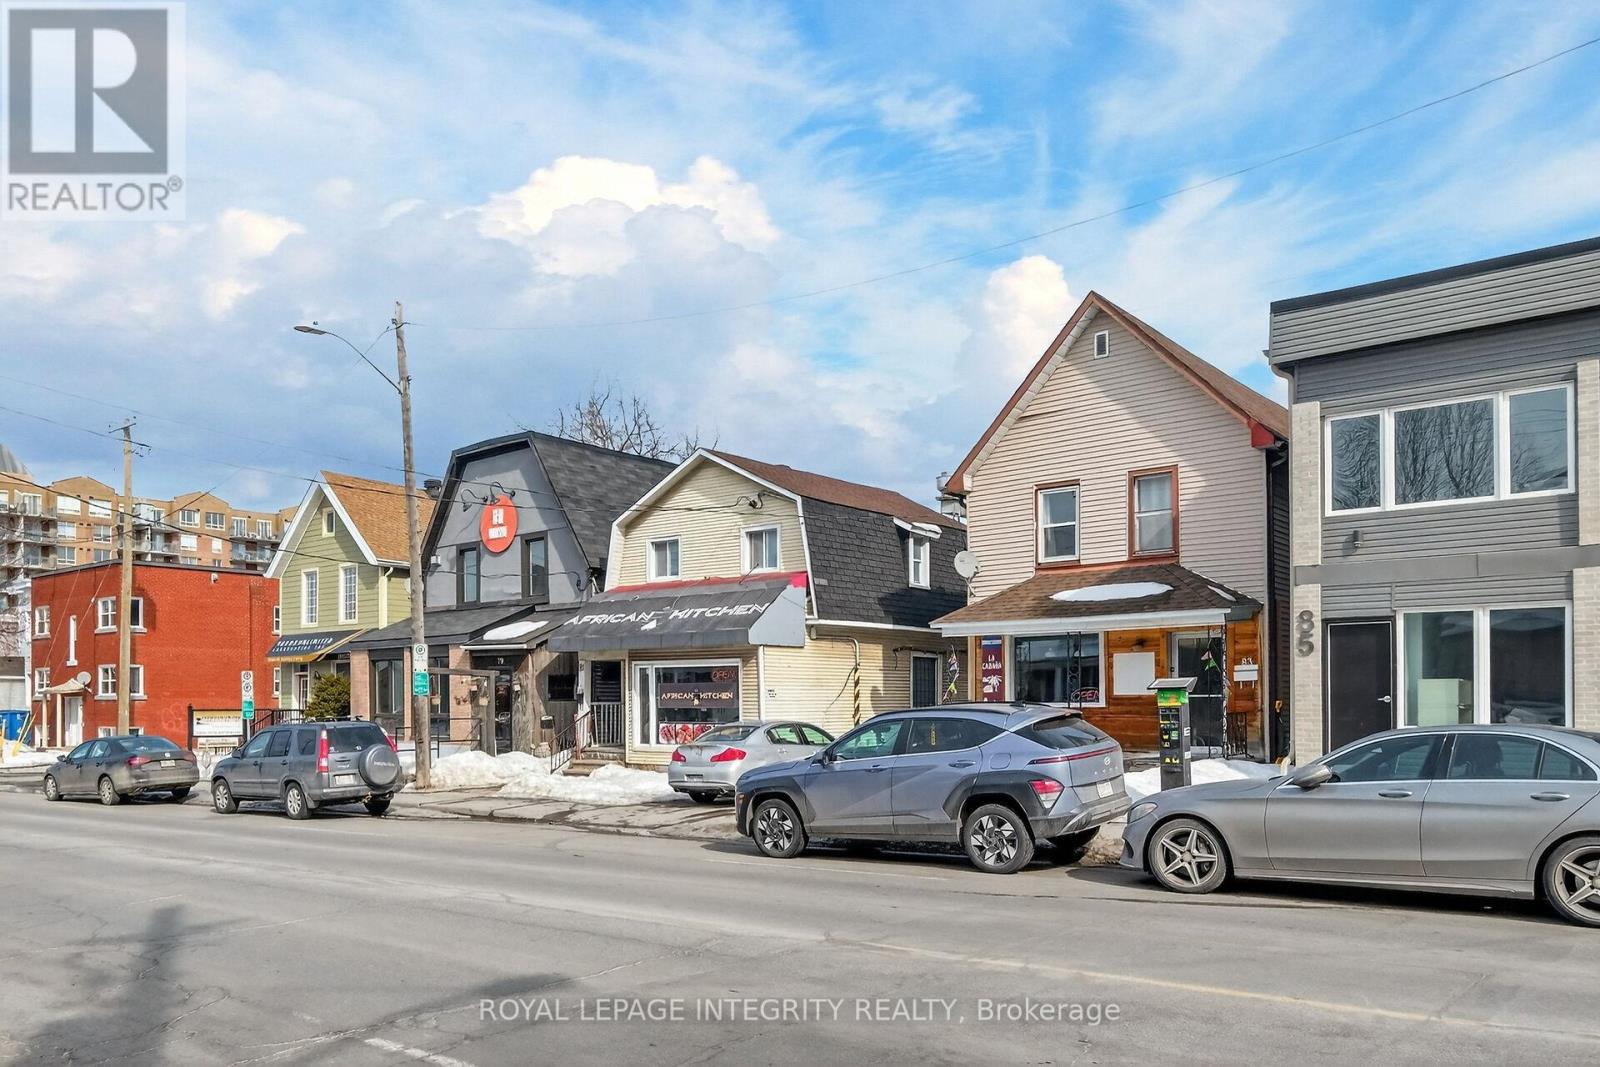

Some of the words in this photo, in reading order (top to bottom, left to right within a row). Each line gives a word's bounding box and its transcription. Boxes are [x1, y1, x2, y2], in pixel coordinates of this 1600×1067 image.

[563, 611, 656, 626] AFRICAN
[668, 602, 770, 620] KITCHEN
[1297, 609, 1315, 657] 85
[988, 654, 995, 662] LA
[661, 692, 695, 700] AFRICAN
[699, 691, 733, 699] KITCHEN
[1072, 689, 1099, 702] OPEN
